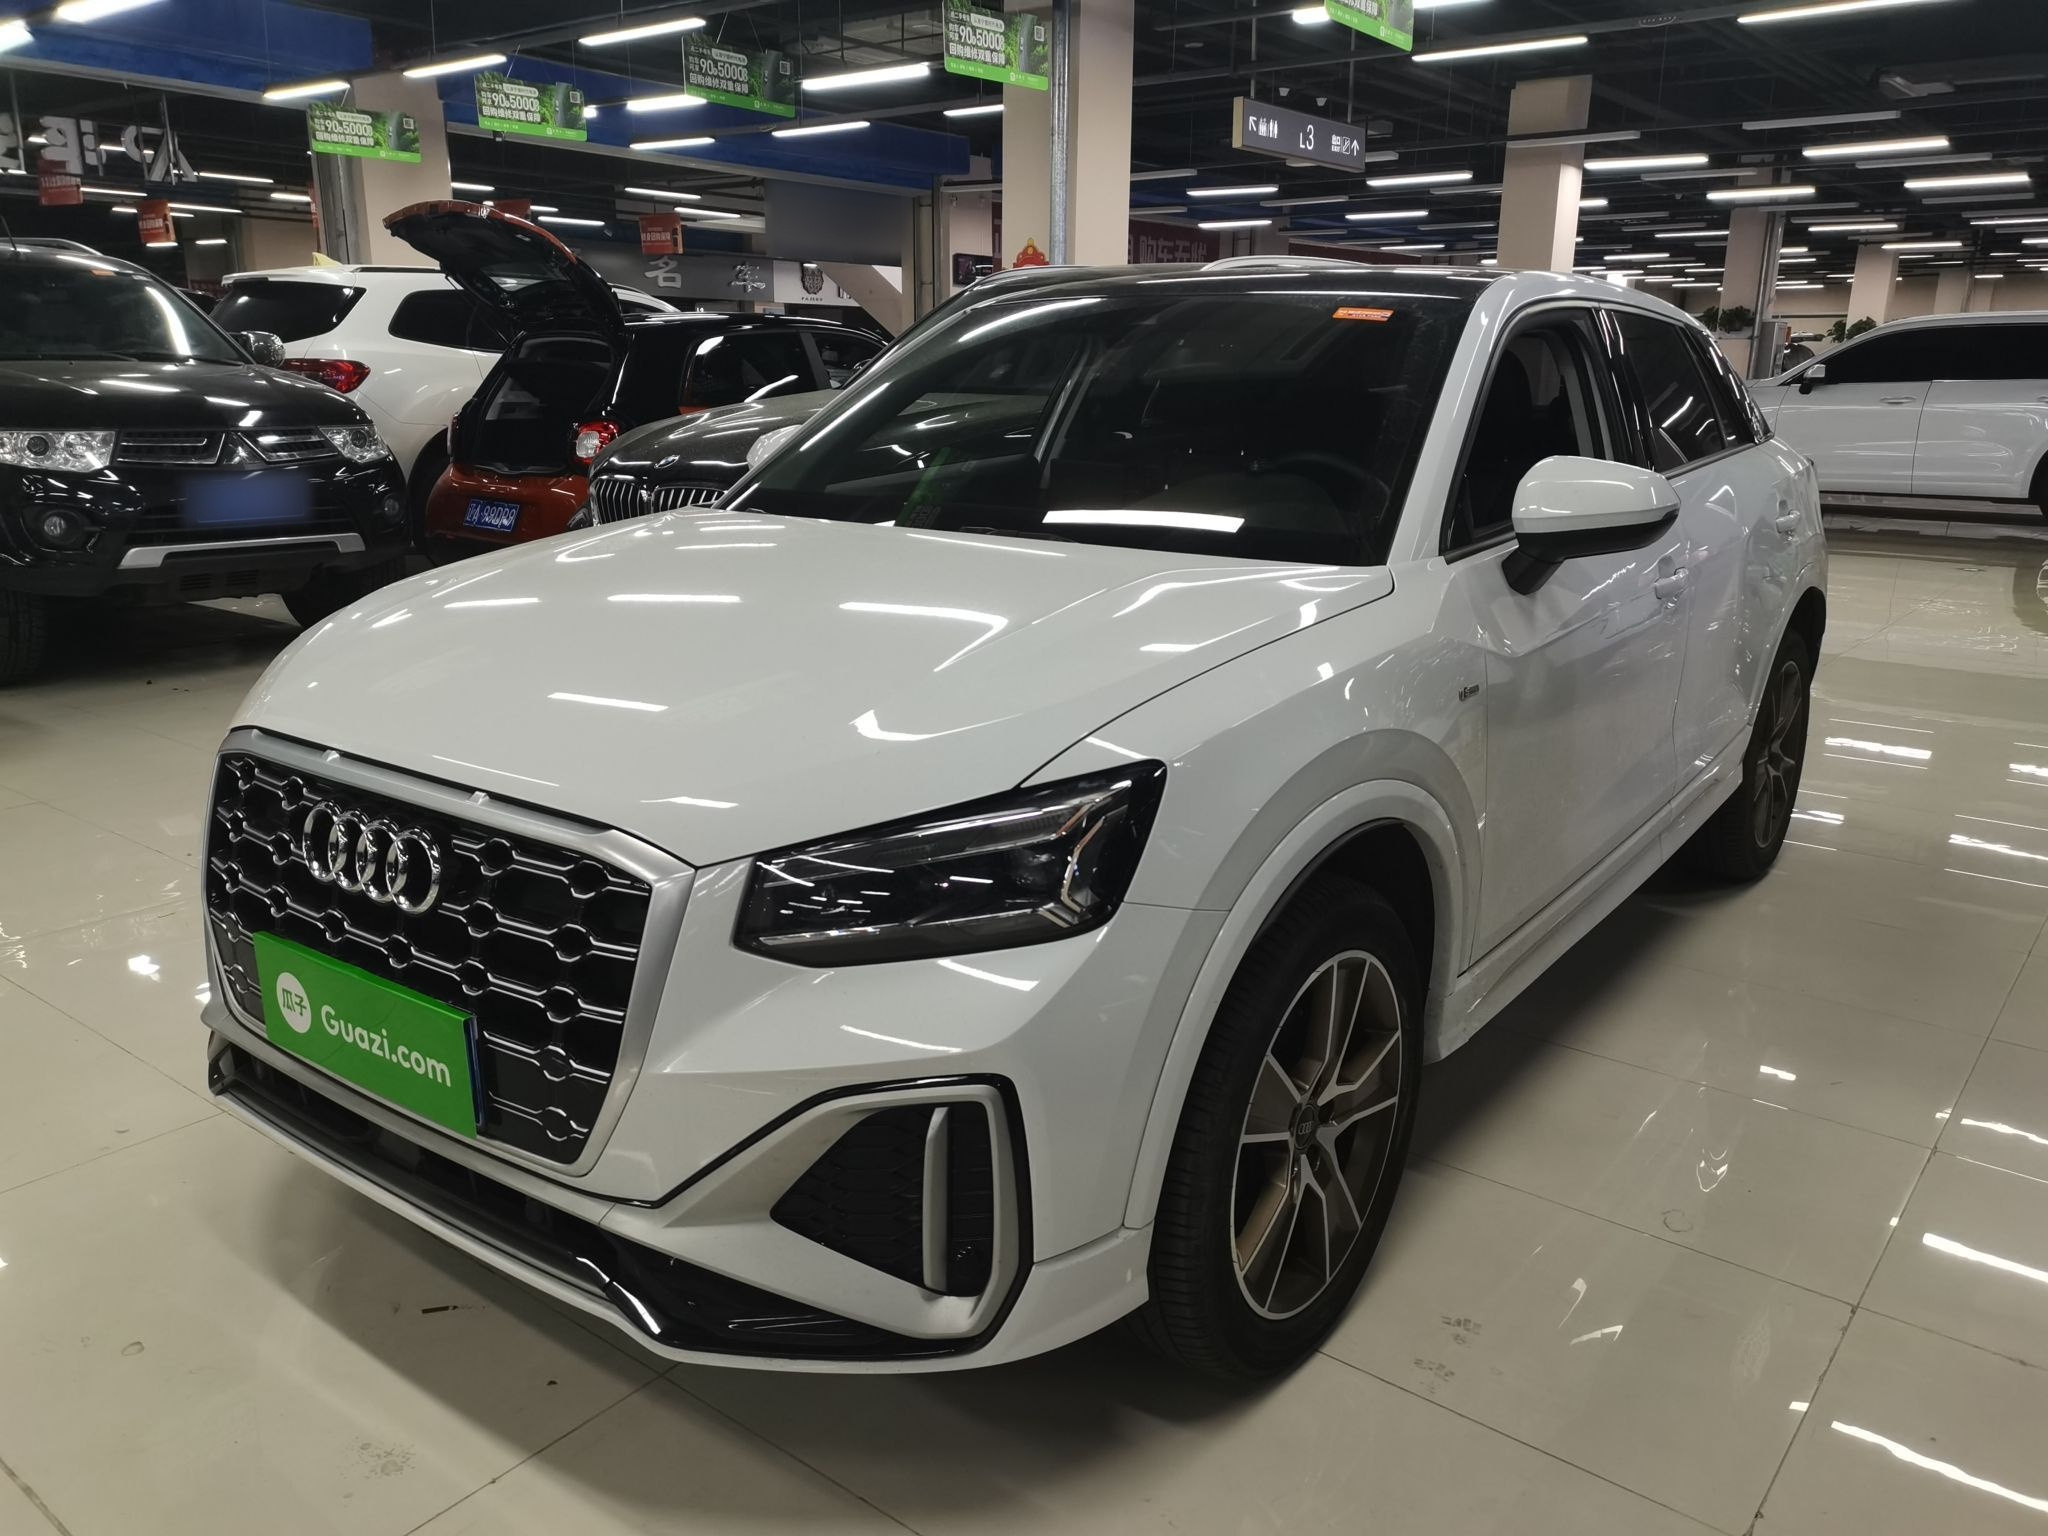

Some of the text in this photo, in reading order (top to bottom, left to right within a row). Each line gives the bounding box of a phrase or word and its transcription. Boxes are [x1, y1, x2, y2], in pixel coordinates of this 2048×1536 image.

[1300, 124, 1314, 150] L3
[282, 987, 307, 1016] 瓜子
[321, 1005, 451, 1087] Guazi.com
